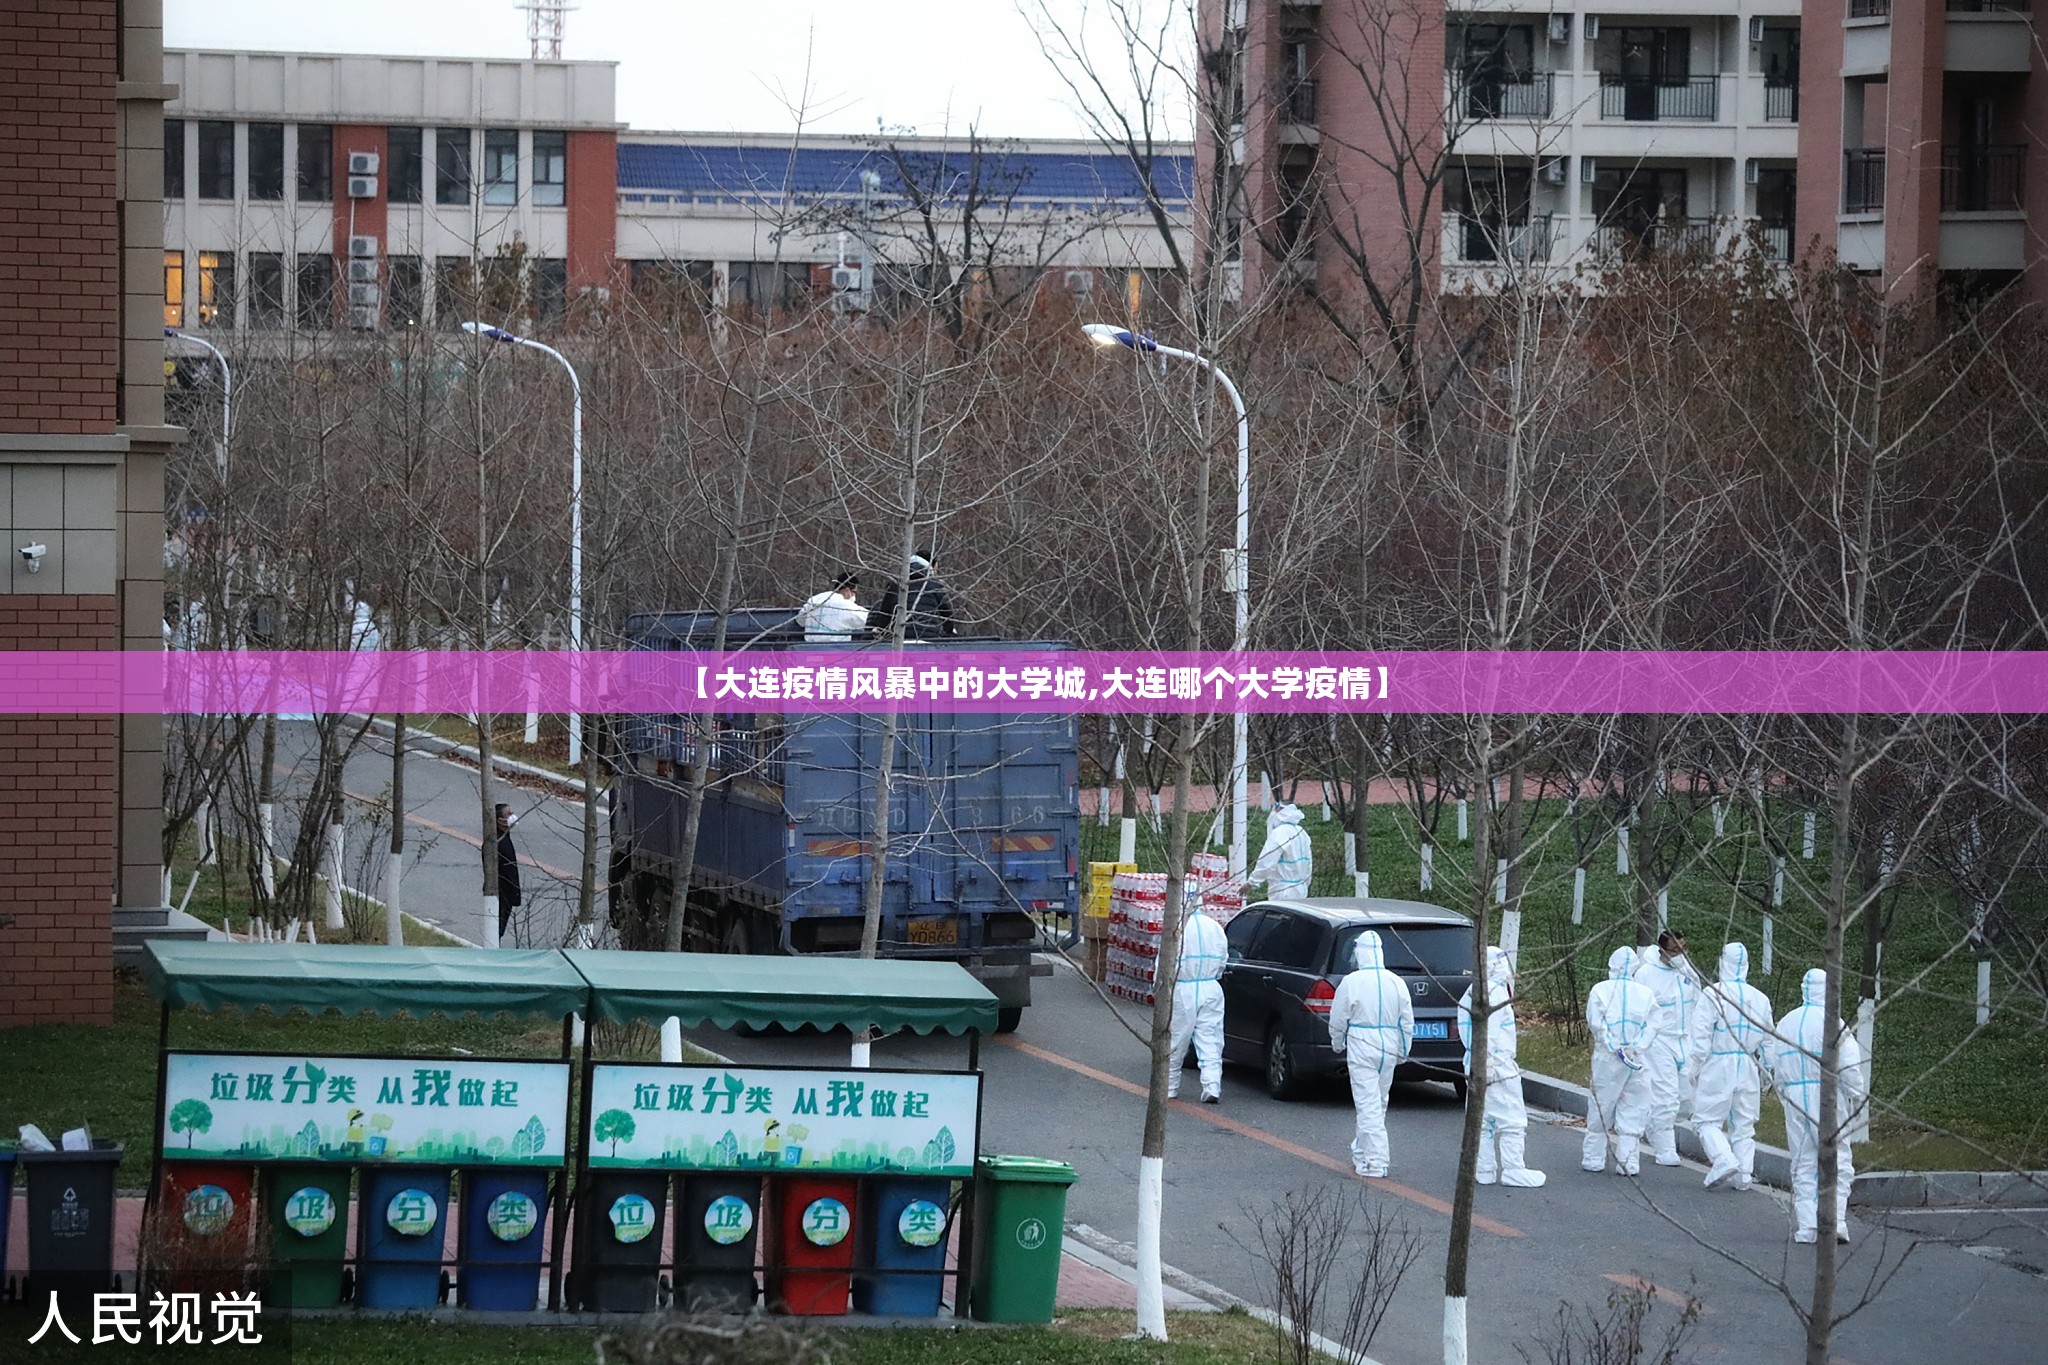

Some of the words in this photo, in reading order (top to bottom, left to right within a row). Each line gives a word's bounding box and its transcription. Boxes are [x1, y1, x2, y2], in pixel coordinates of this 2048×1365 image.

[911, 931, 955, 944] YD866
[211, 1061, 356, 1104] 垃圾分类
[377, 1069, 519, 1107] 从我做起
[633, 1071, 772, 1114] 垃圾分类
[792, 1080, 930, 1118] 从我做起
[296, 1195, 325, 1220] 圾
[398, 1198, 426, 1222] 分
[499, 1199, 527, 1223] 类
[617, 1203, 644, 1226] 垃
[714, 1203, 742, 1228] 圾
[812, 1205, 840, 1230] 分
[909, 1208, 936, 1231] 类
